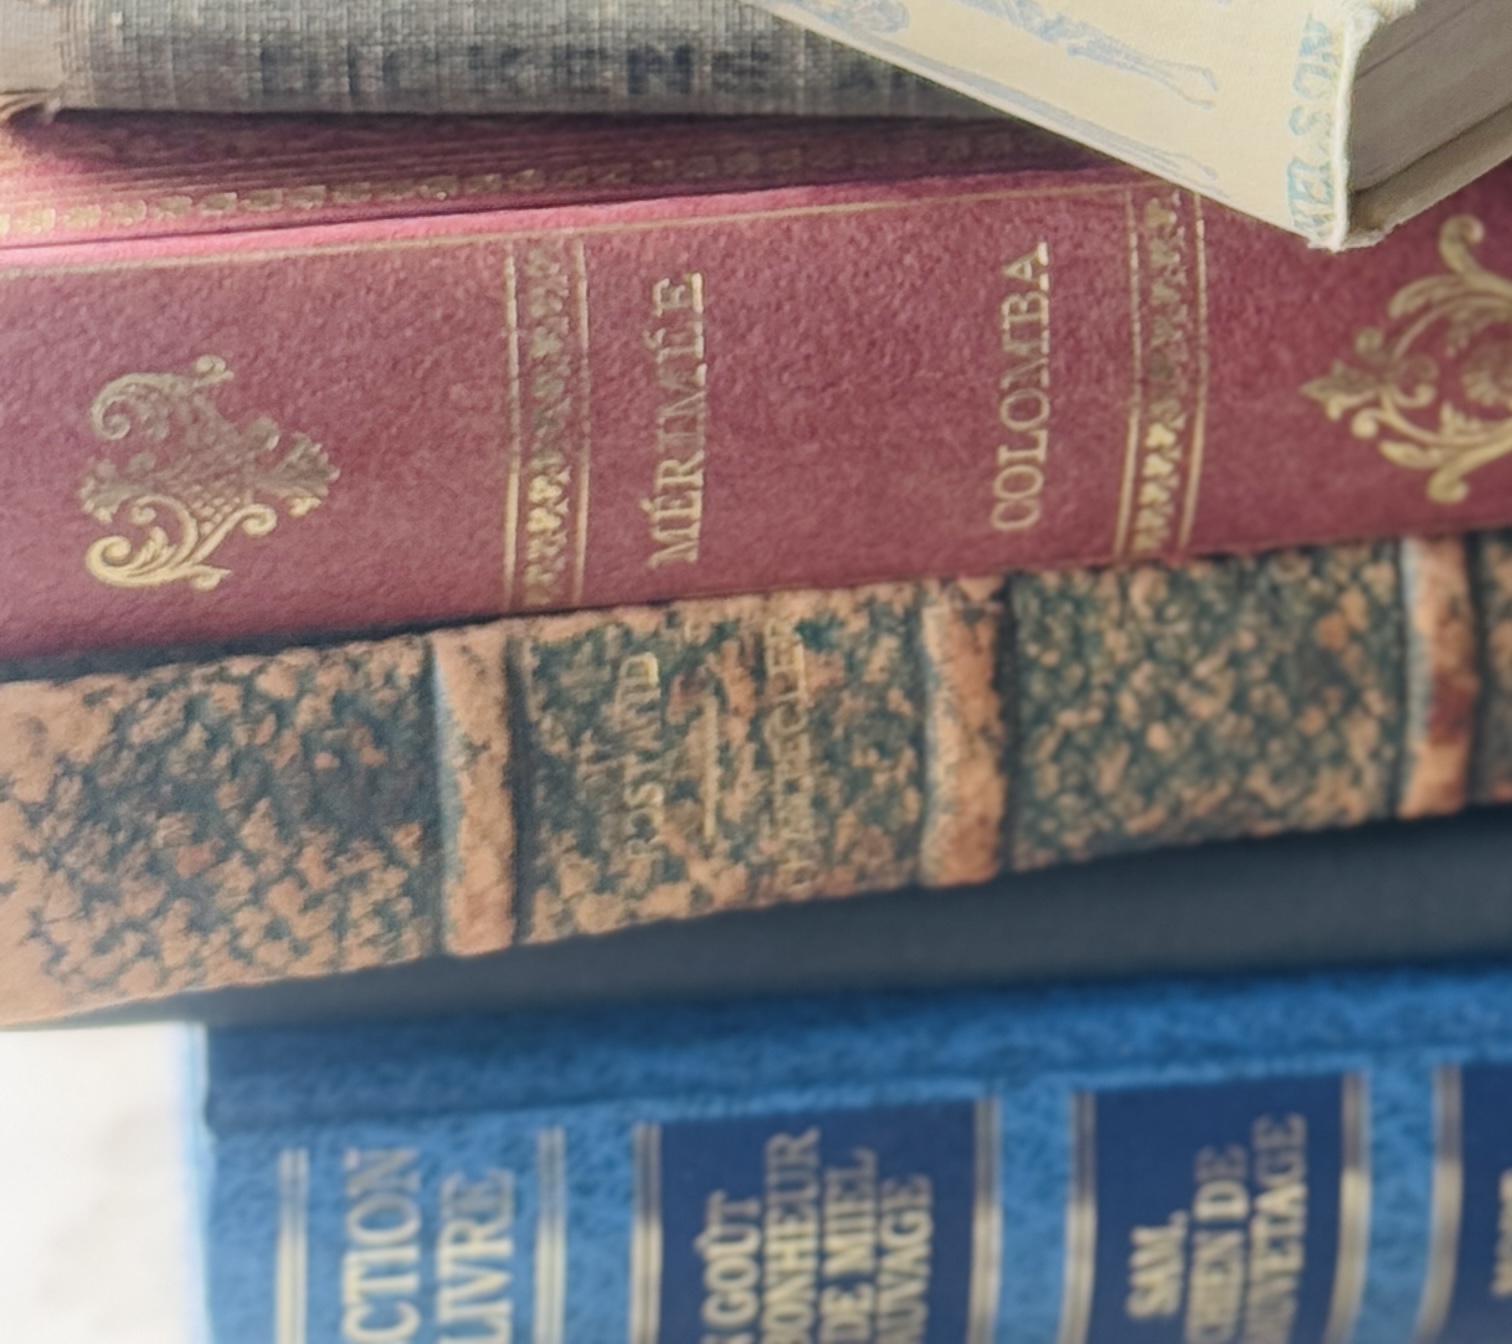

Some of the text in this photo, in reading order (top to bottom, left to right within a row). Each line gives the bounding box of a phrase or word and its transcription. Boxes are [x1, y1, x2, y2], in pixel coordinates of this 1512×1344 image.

[639, 270, 707, 568] MÉRIMÉE
[989, 239, 1050, 531] COLOMBA
[340, 1148, 421, 1344] CTION
[436, 1169, 514, 1344] LIVRE
[822, 1146, 876, 1278] MIEL
[1193, 1144, 1249, 1223] DE
